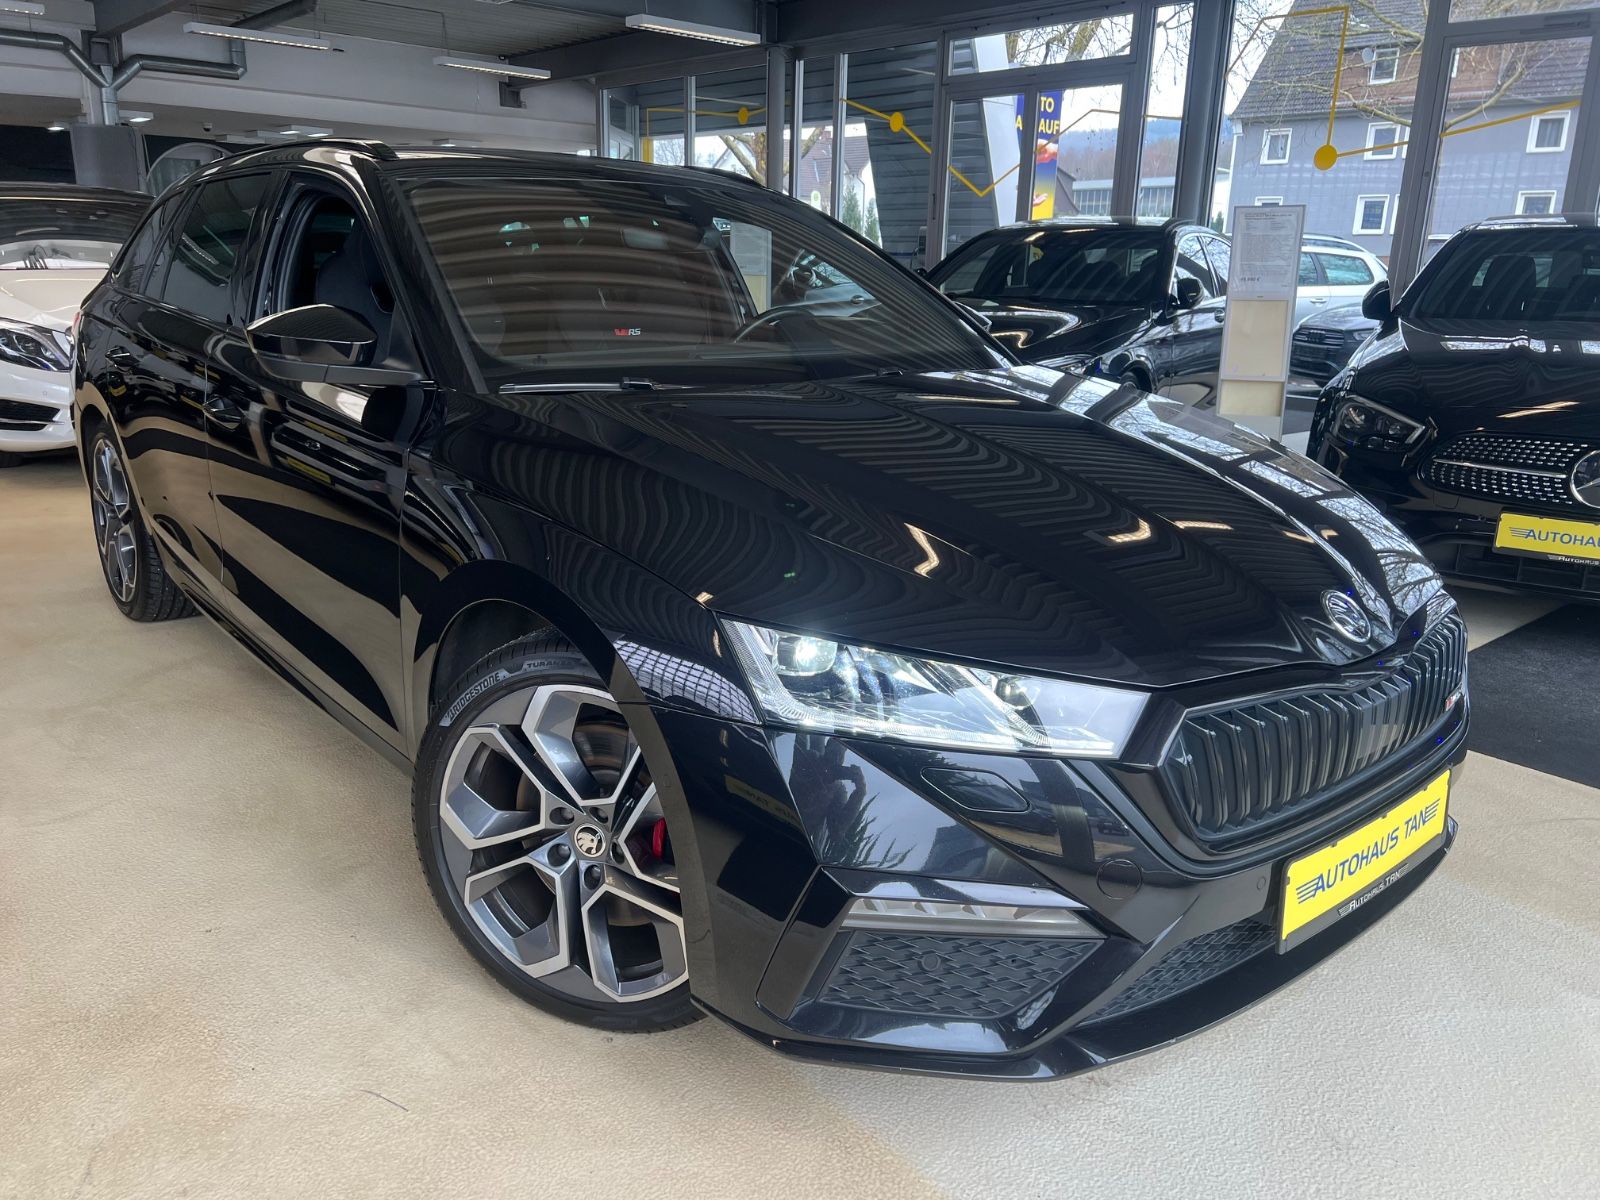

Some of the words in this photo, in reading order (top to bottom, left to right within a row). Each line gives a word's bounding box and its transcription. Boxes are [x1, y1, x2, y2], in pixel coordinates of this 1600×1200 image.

[1524, 529, 1600, 547] AUTOHA
[445, 672, 501, 722] BRIDGESTONE
[1313, 827, 1400, 898] AUTOHAUS
[1404, 808, 1428, 839] TAN
